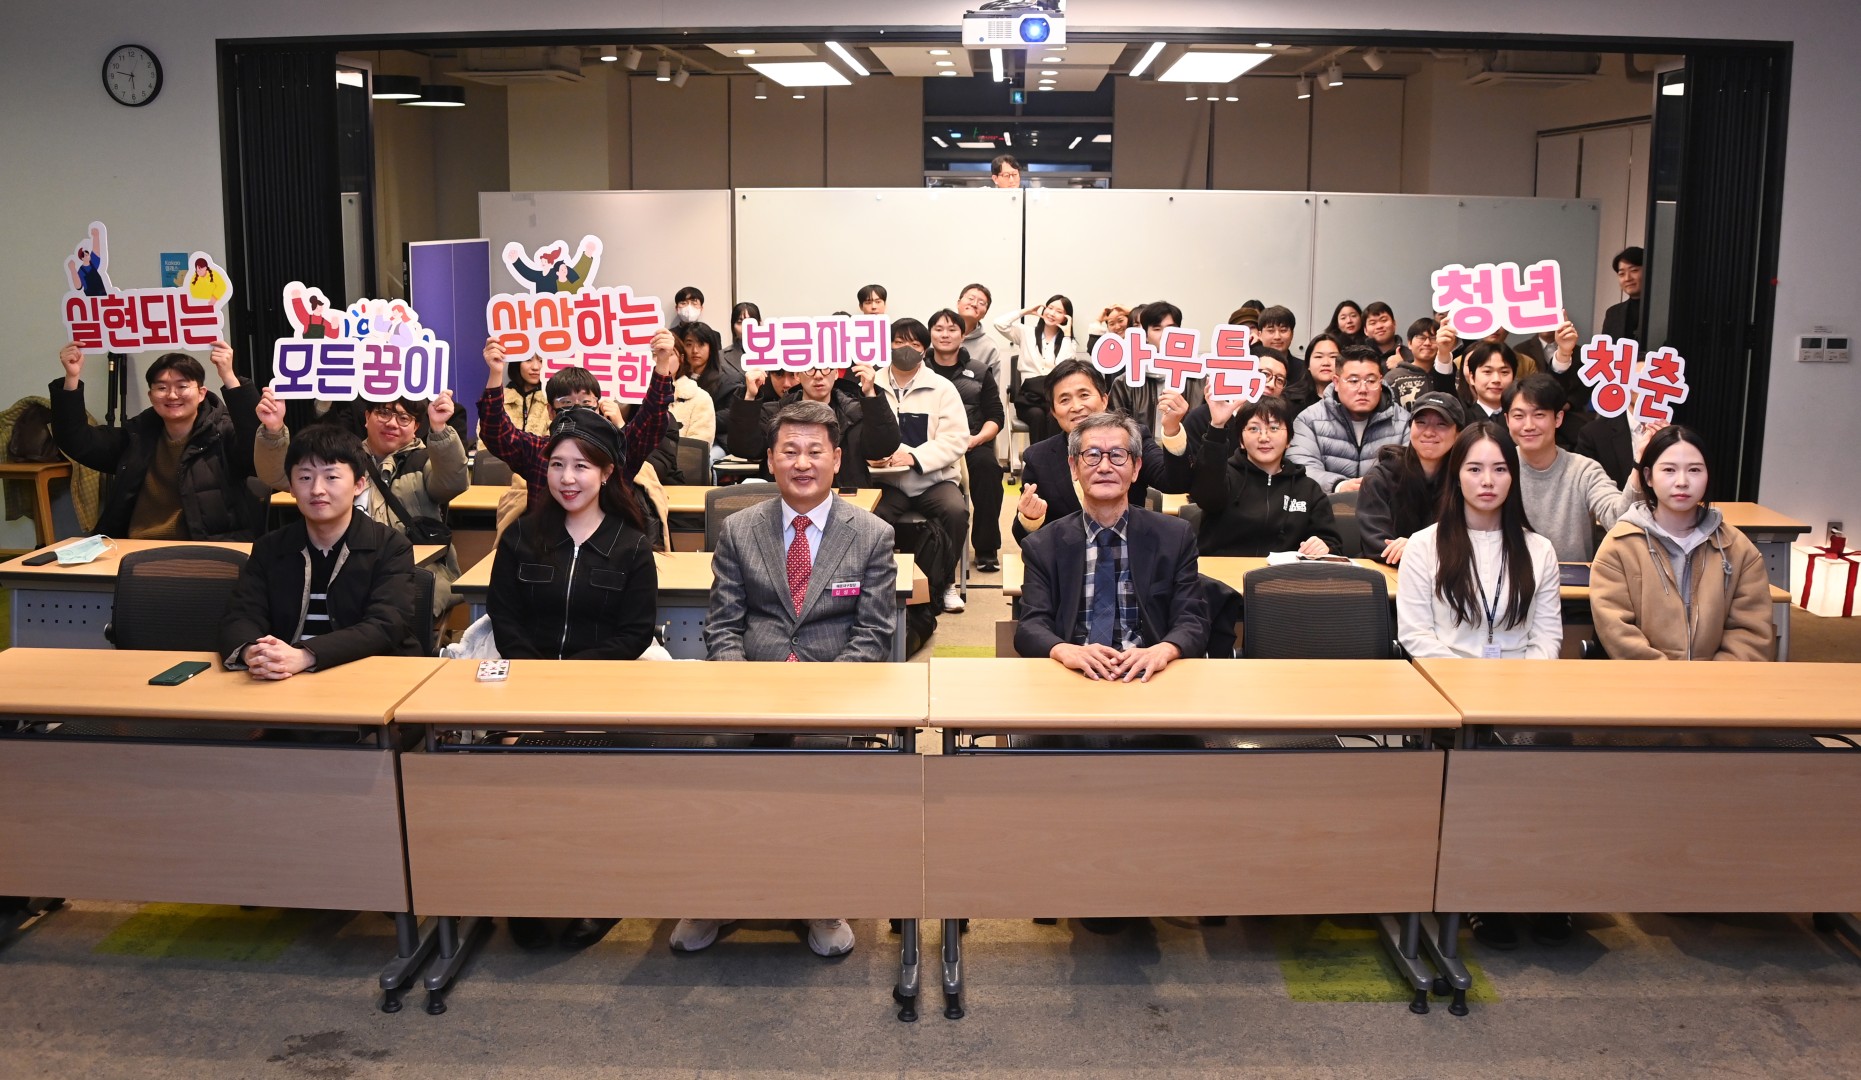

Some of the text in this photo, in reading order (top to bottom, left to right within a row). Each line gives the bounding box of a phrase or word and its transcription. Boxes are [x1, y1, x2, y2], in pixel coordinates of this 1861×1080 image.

[66, 294, 219, 349] 실현되는
[492, 293, 659, 355] 상상하는
[1437, 265, 1559, 334] 청년
[274, 343, 443, 396] 모든 꿈이
[745, 320, 887, 367] 보금자리
[1097, 329, 1261, 397] 아무튼,
[1584, 340, 1684, 419] 청춘
